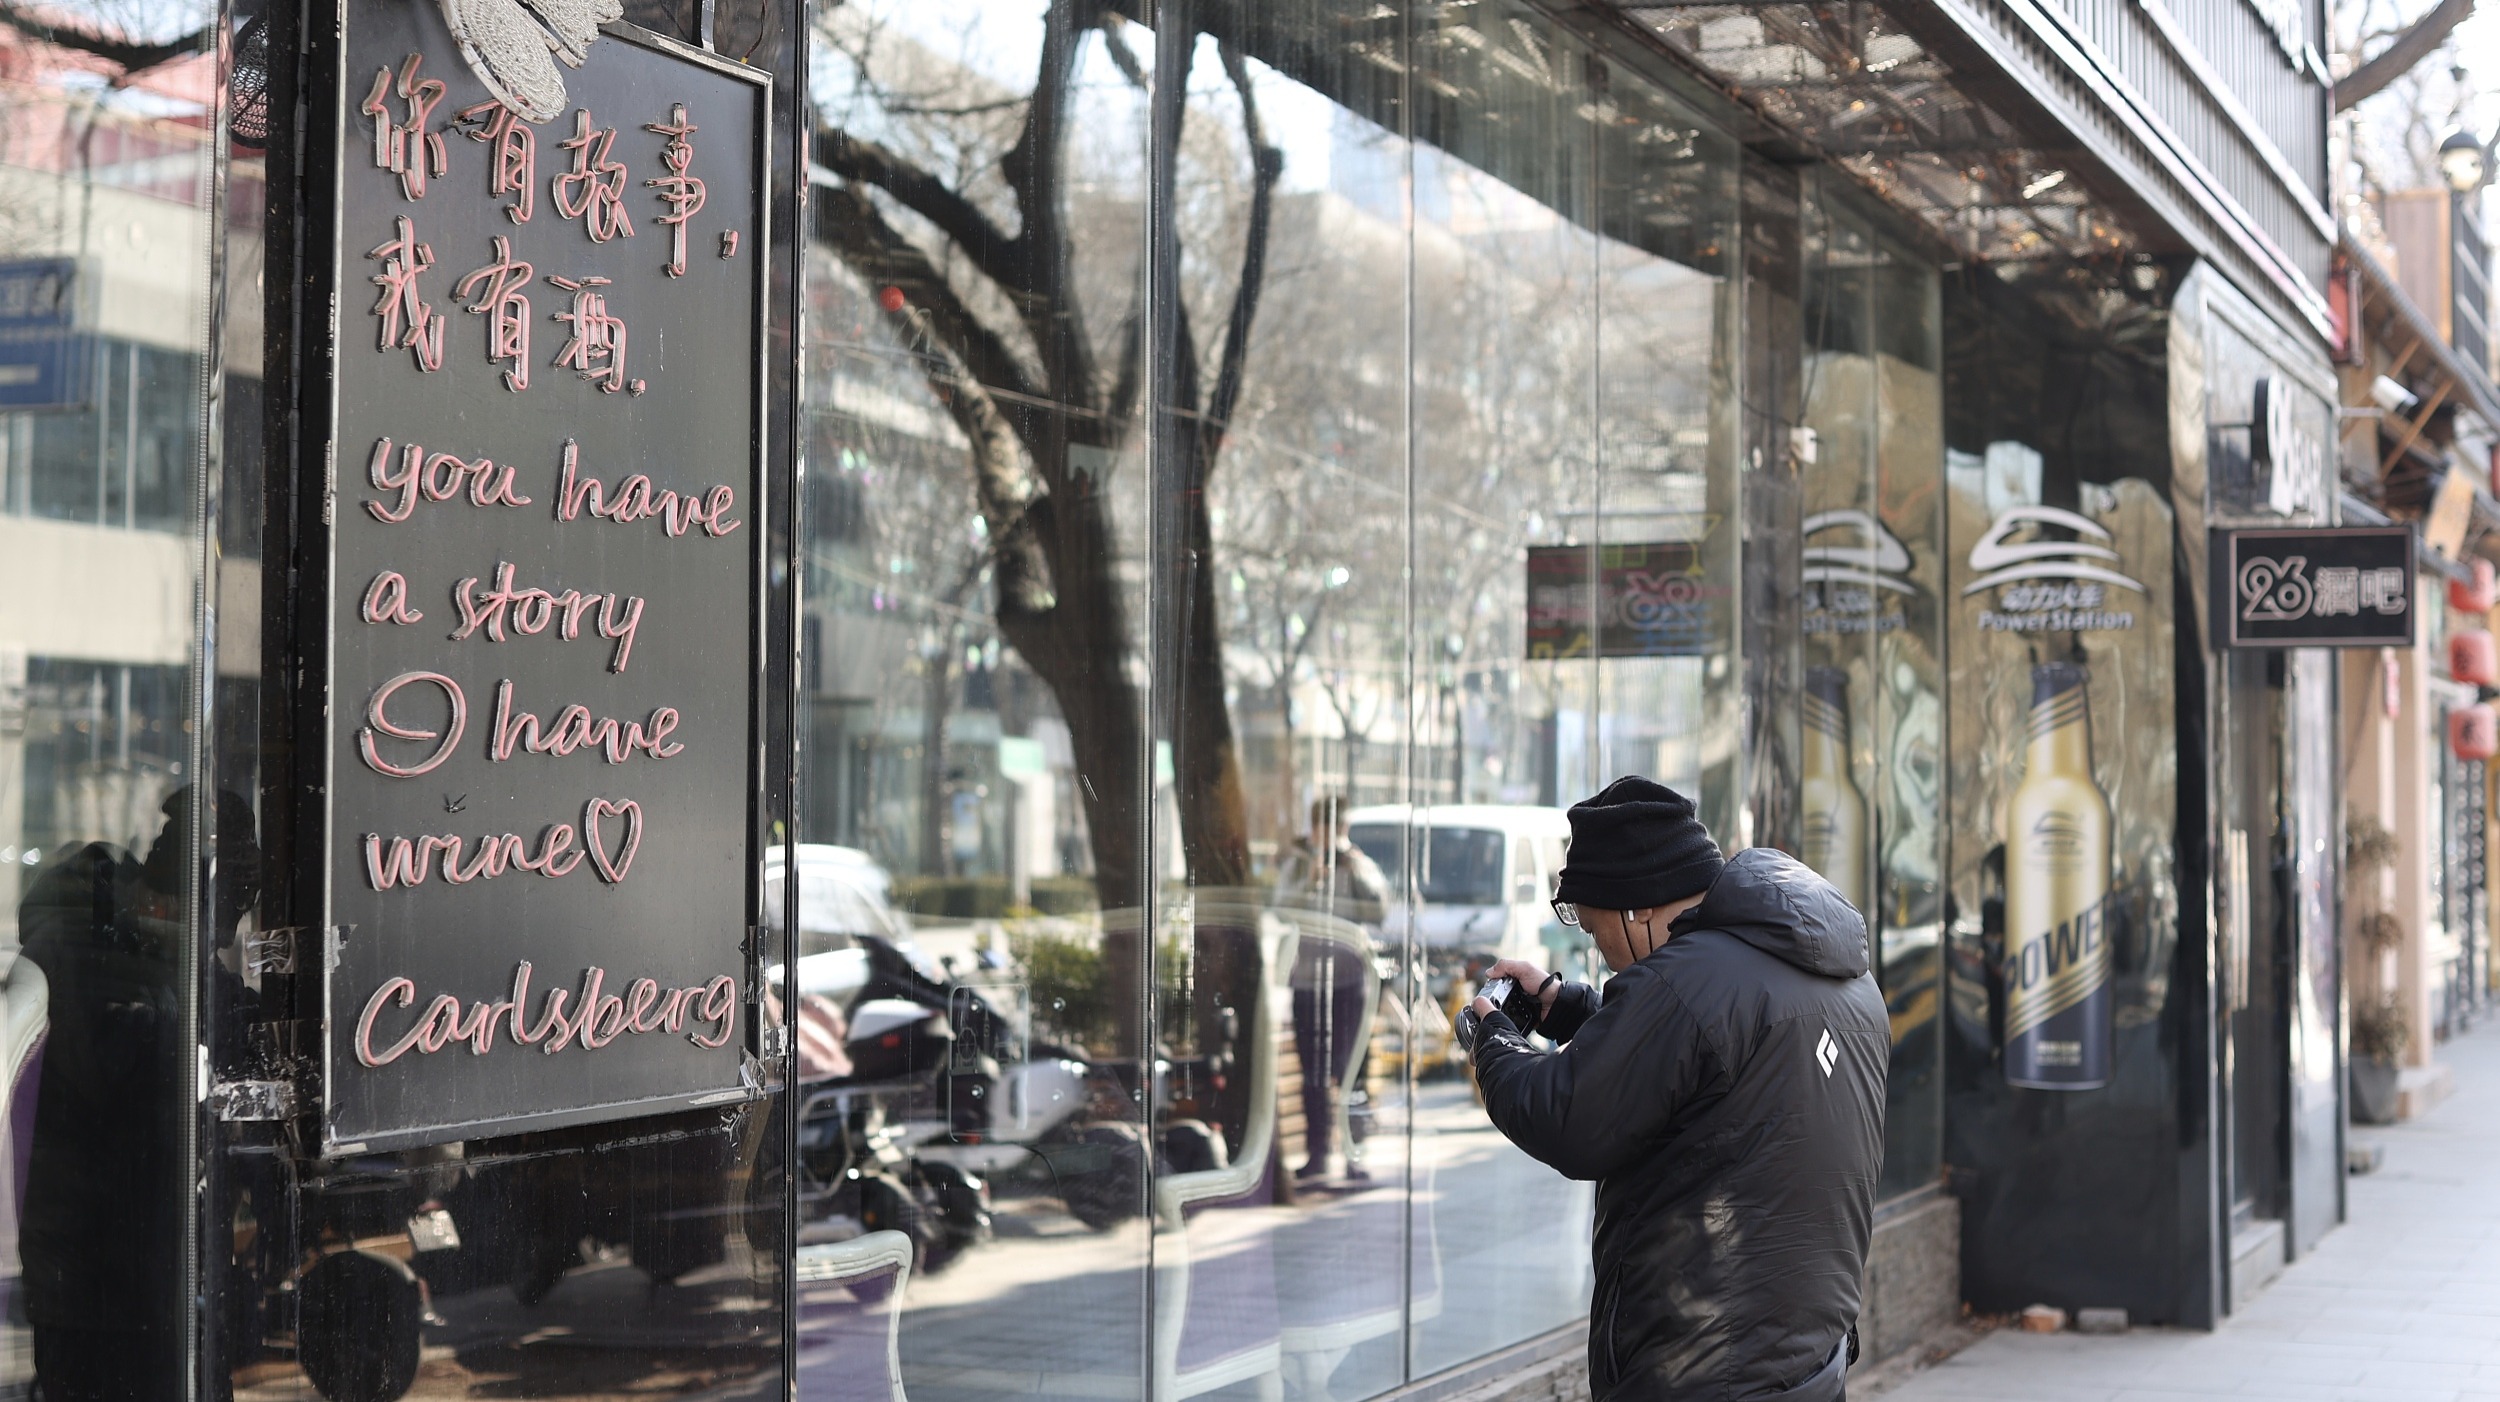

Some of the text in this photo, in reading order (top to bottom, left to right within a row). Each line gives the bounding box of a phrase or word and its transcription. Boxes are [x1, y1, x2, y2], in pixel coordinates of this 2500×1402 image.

[366, 436, 742, 538] you have
[363, 561, 645, 674] a story
[491, 679, 685, 765] have
[365, 823, 586, 891] wine
[355, 960, 736, 1068] Carlsberg
